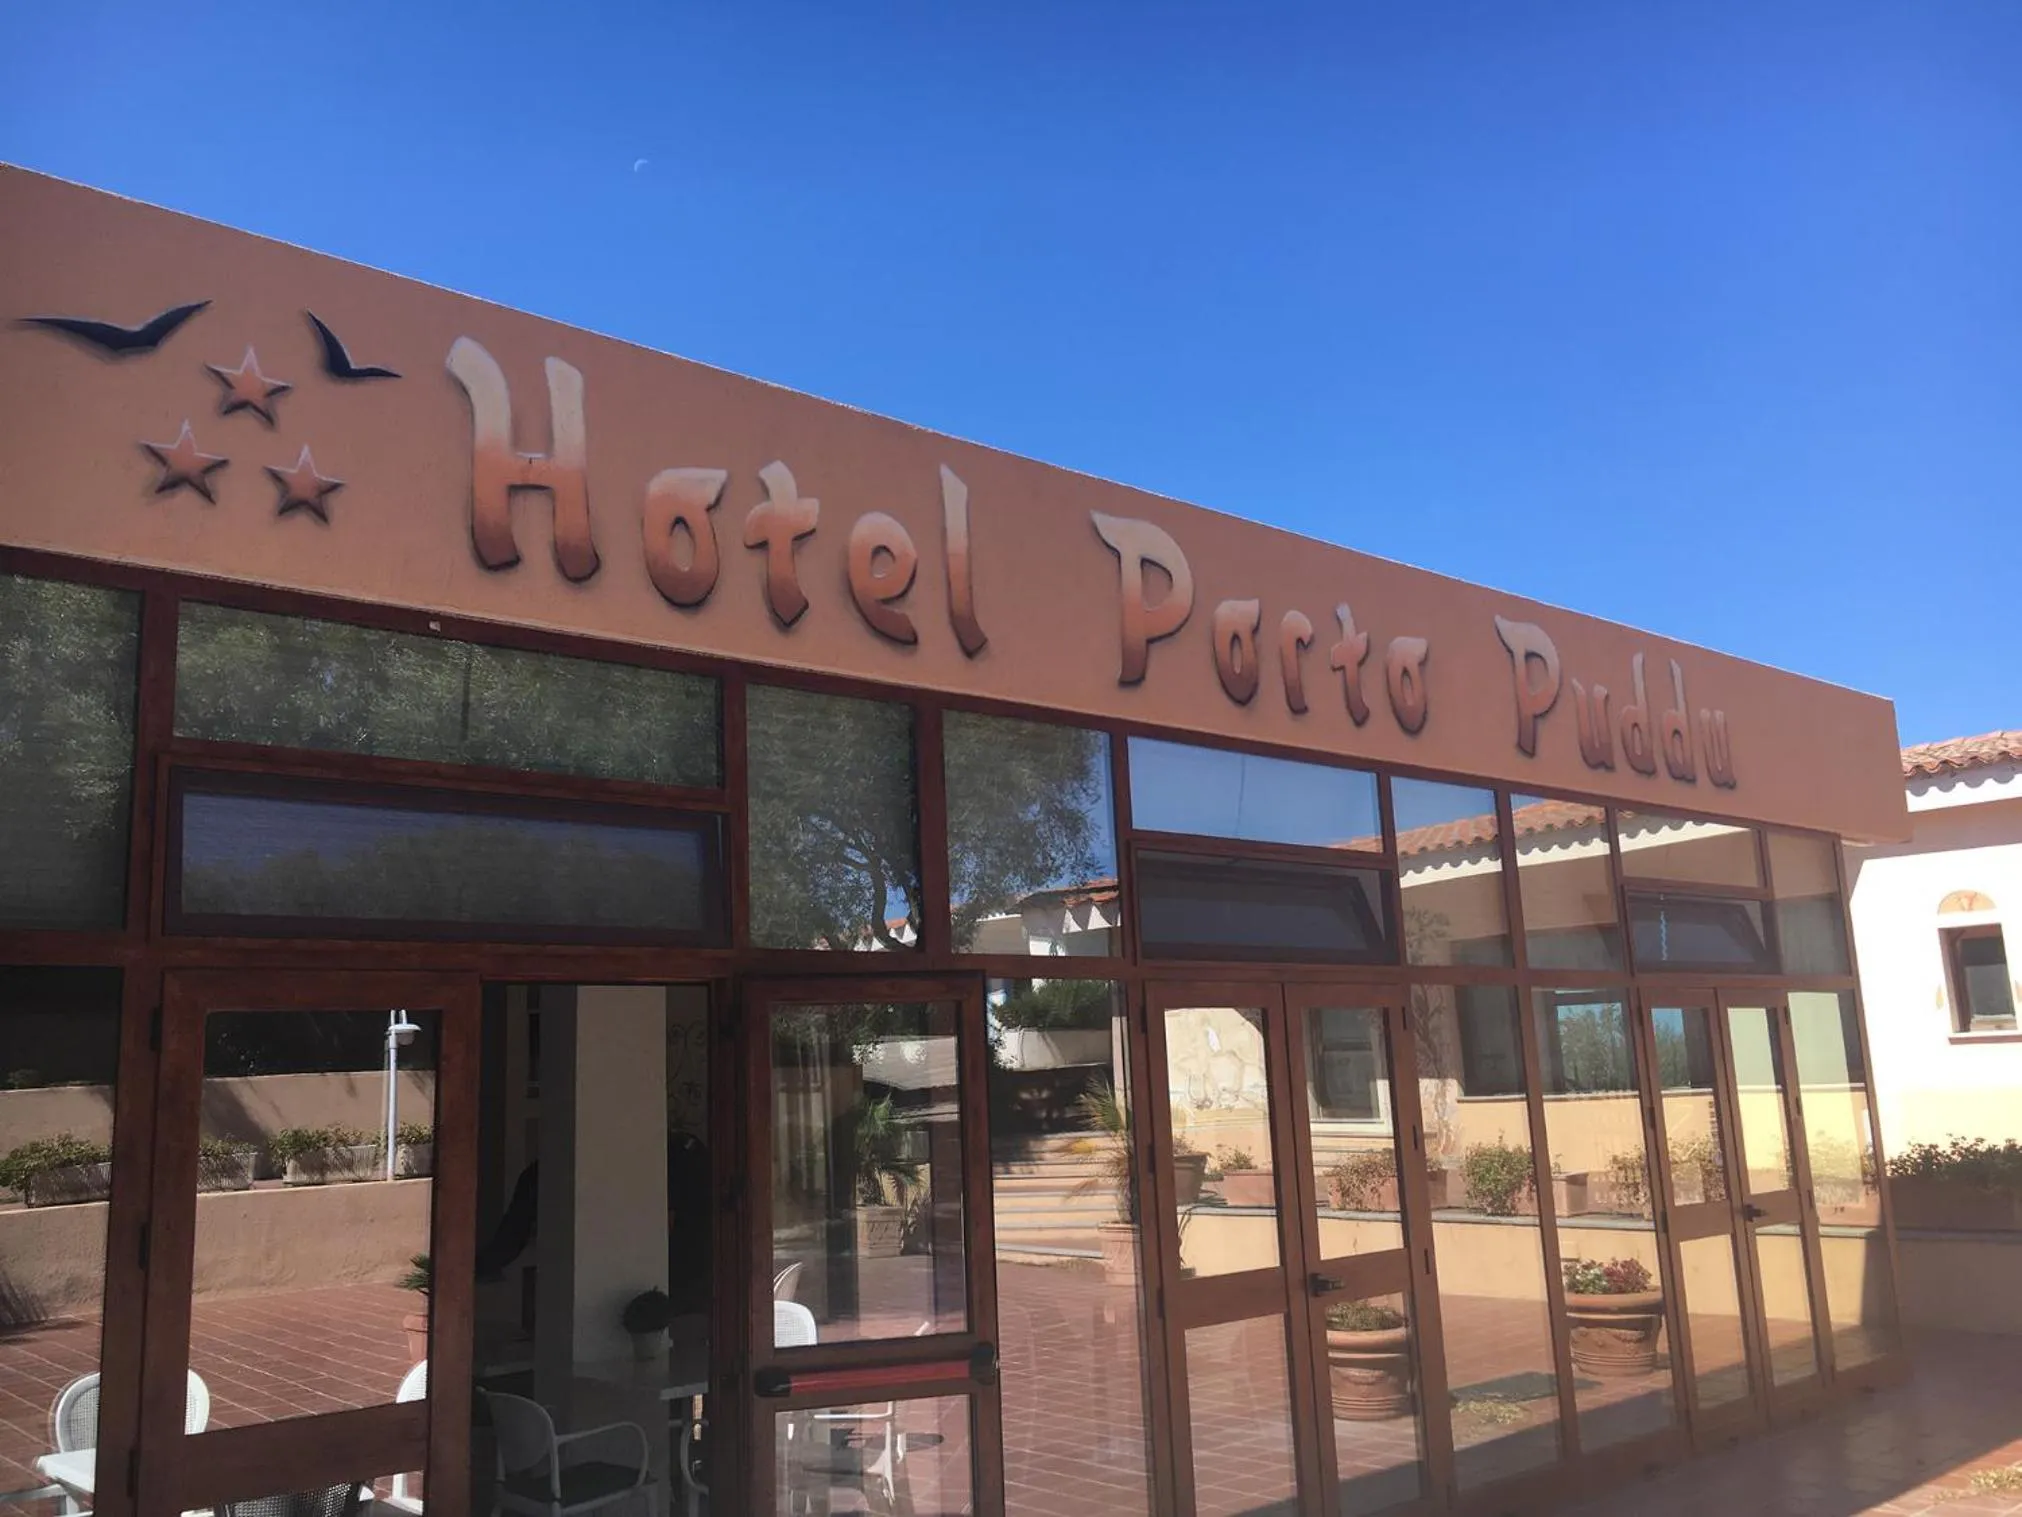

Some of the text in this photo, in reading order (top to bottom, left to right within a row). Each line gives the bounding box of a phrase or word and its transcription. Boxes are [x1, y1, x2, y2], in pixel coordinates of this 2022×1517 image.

[445, 335, 1737, 790] Hotel Porto Puddu
